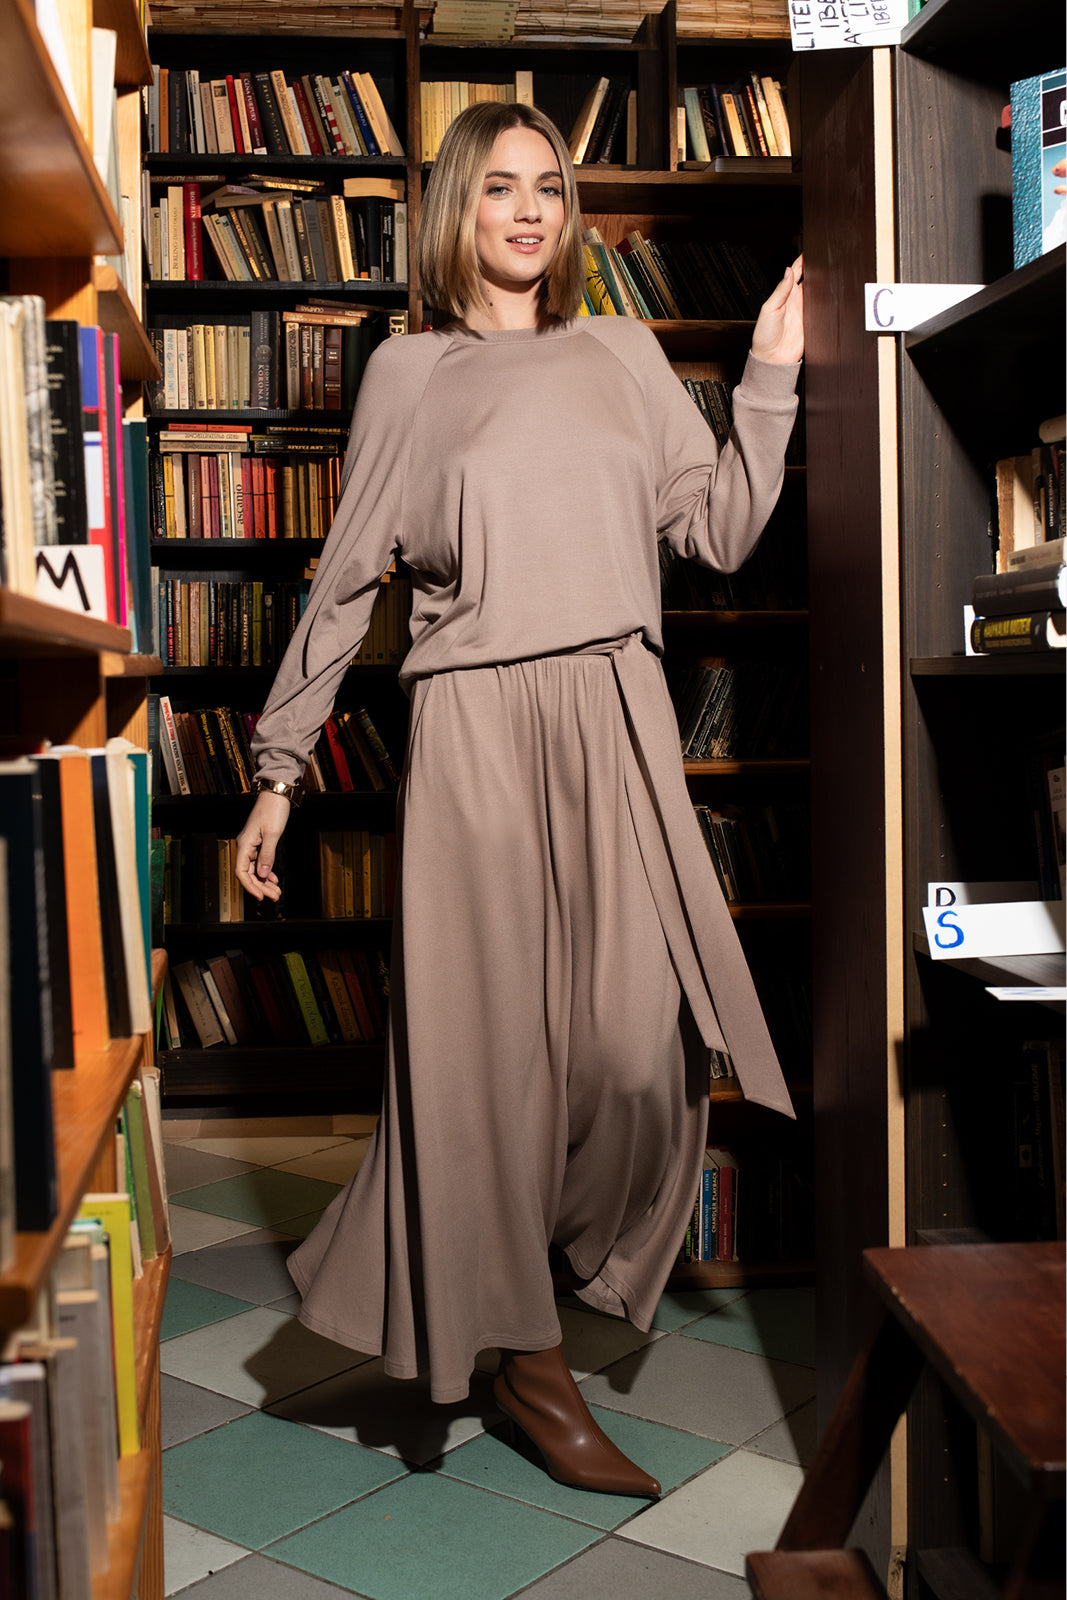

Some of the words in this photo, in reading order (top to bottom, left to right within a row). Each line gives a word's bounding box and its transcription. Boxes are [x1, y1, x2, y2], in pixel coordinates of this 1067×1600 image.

[792, 0, 815, 48] LITE
[873, 288, 895, 328] C
[233, 484, 244, 525] ascanio
[36, 550, 91, 611] M
[935, 886, 957, 908] D
[934, 910, 965, 949] S
